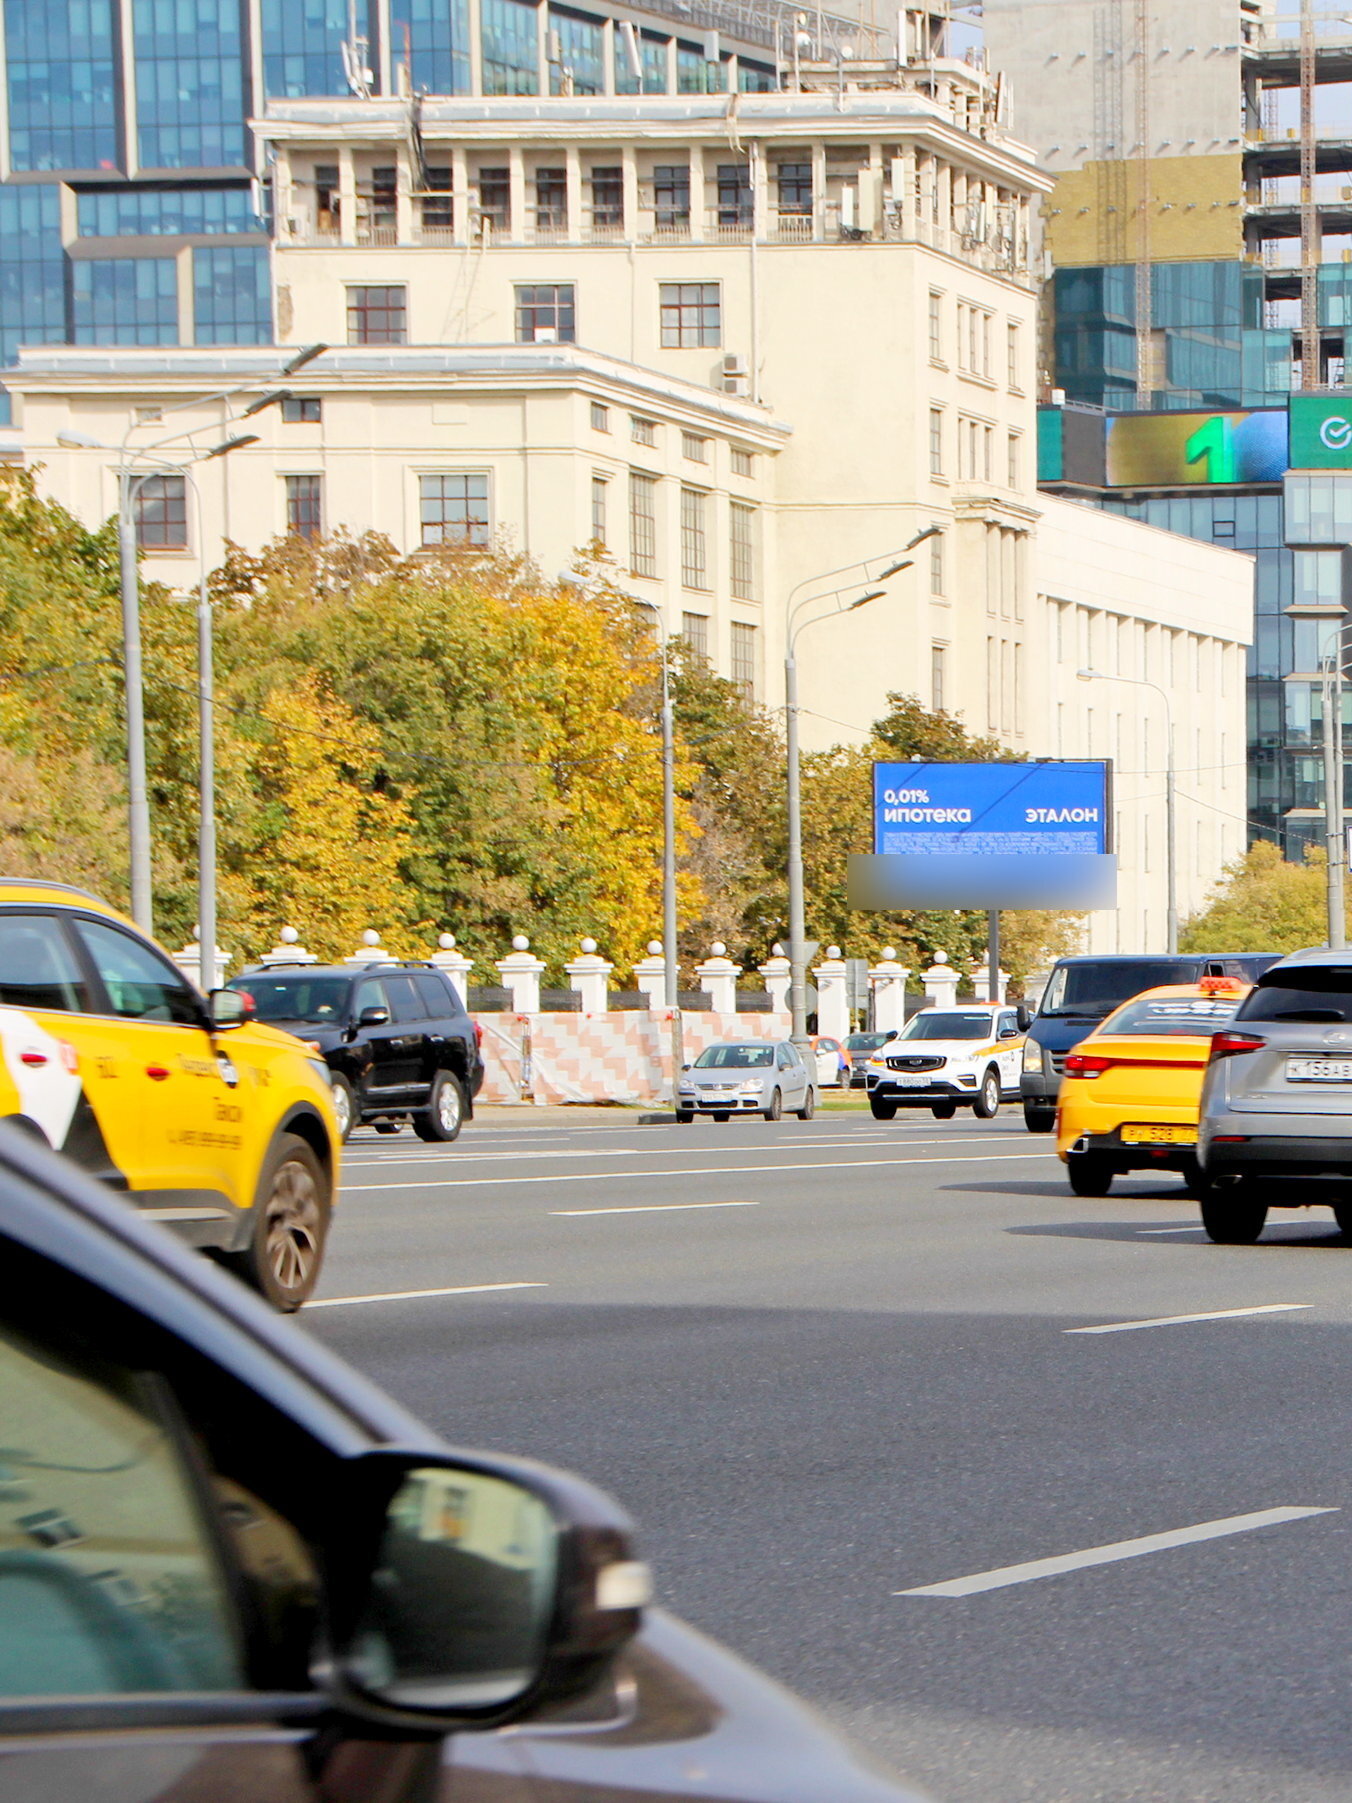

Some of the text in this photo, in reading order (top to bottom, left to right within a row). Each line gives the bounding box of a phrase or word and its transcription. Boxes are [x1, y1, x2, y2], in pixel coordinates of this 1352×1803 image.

[883, 788, 930, 806] 0,01%
[883, 807, 972, 823] ипотека
[1025, 807, 1099, 823] ЭТАЛОН
